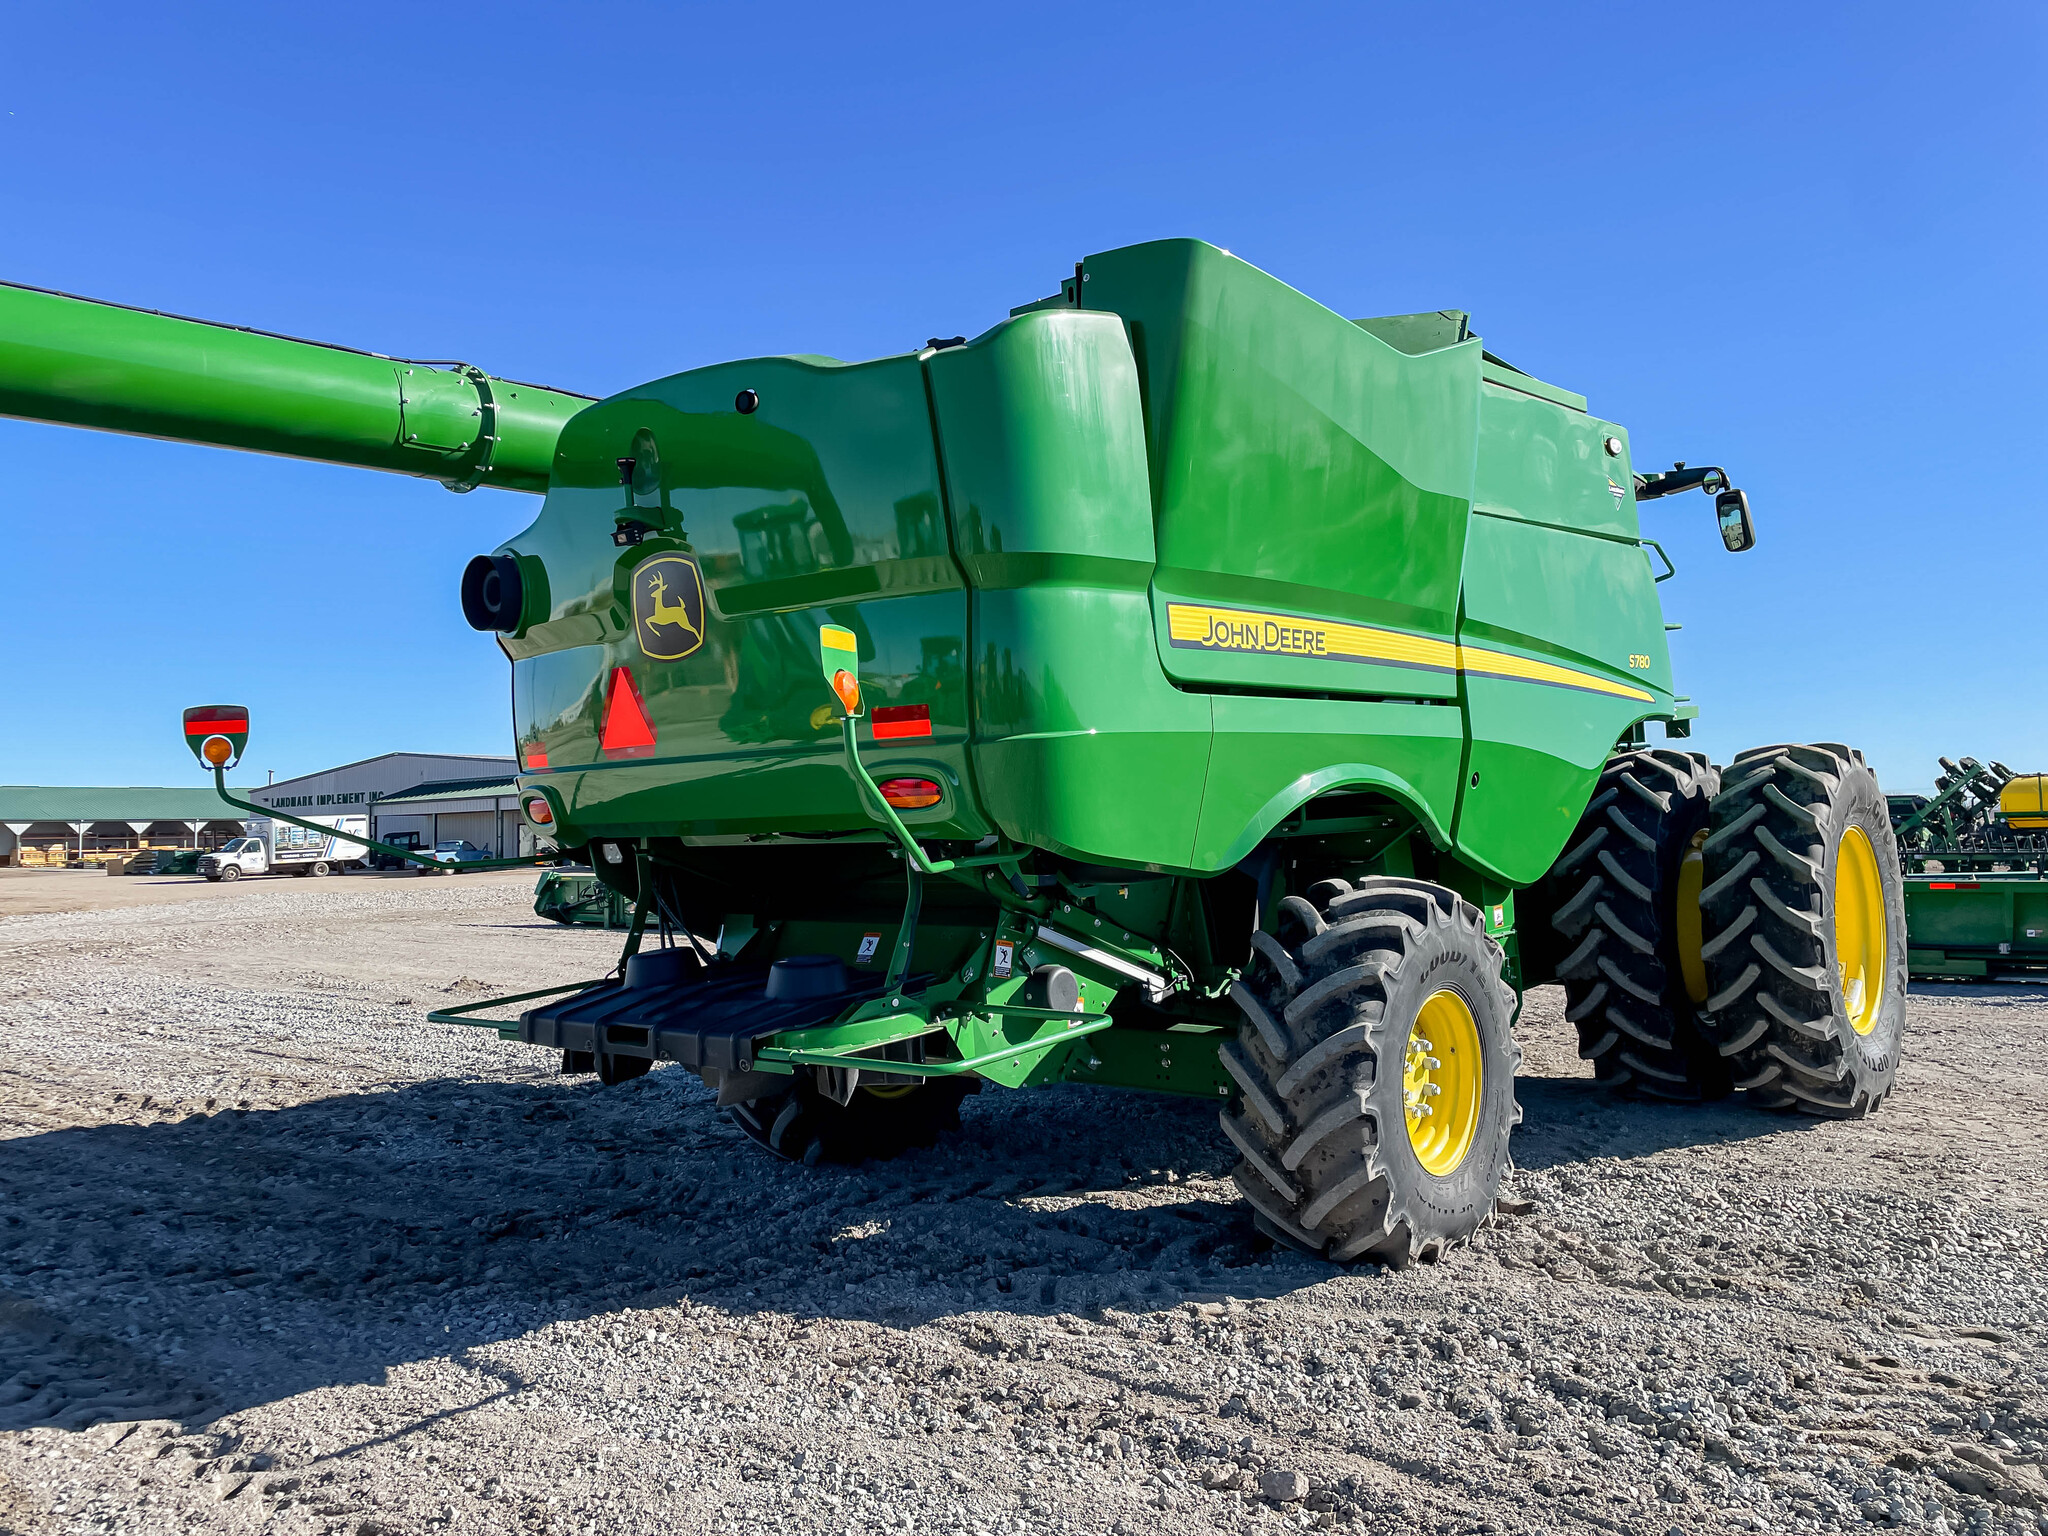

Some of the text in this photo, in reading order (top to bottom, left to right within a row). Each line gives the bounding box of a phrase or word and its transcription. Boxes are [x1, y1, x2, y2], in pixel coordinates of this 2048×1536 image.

[1202, 615, 1326, 652] JOHN DEERE
[1629, 654, 1650, 669] S780
[271, 795, 313, 808] LANDMARK
[317, 792, 365, 806] IMPLEMENT
